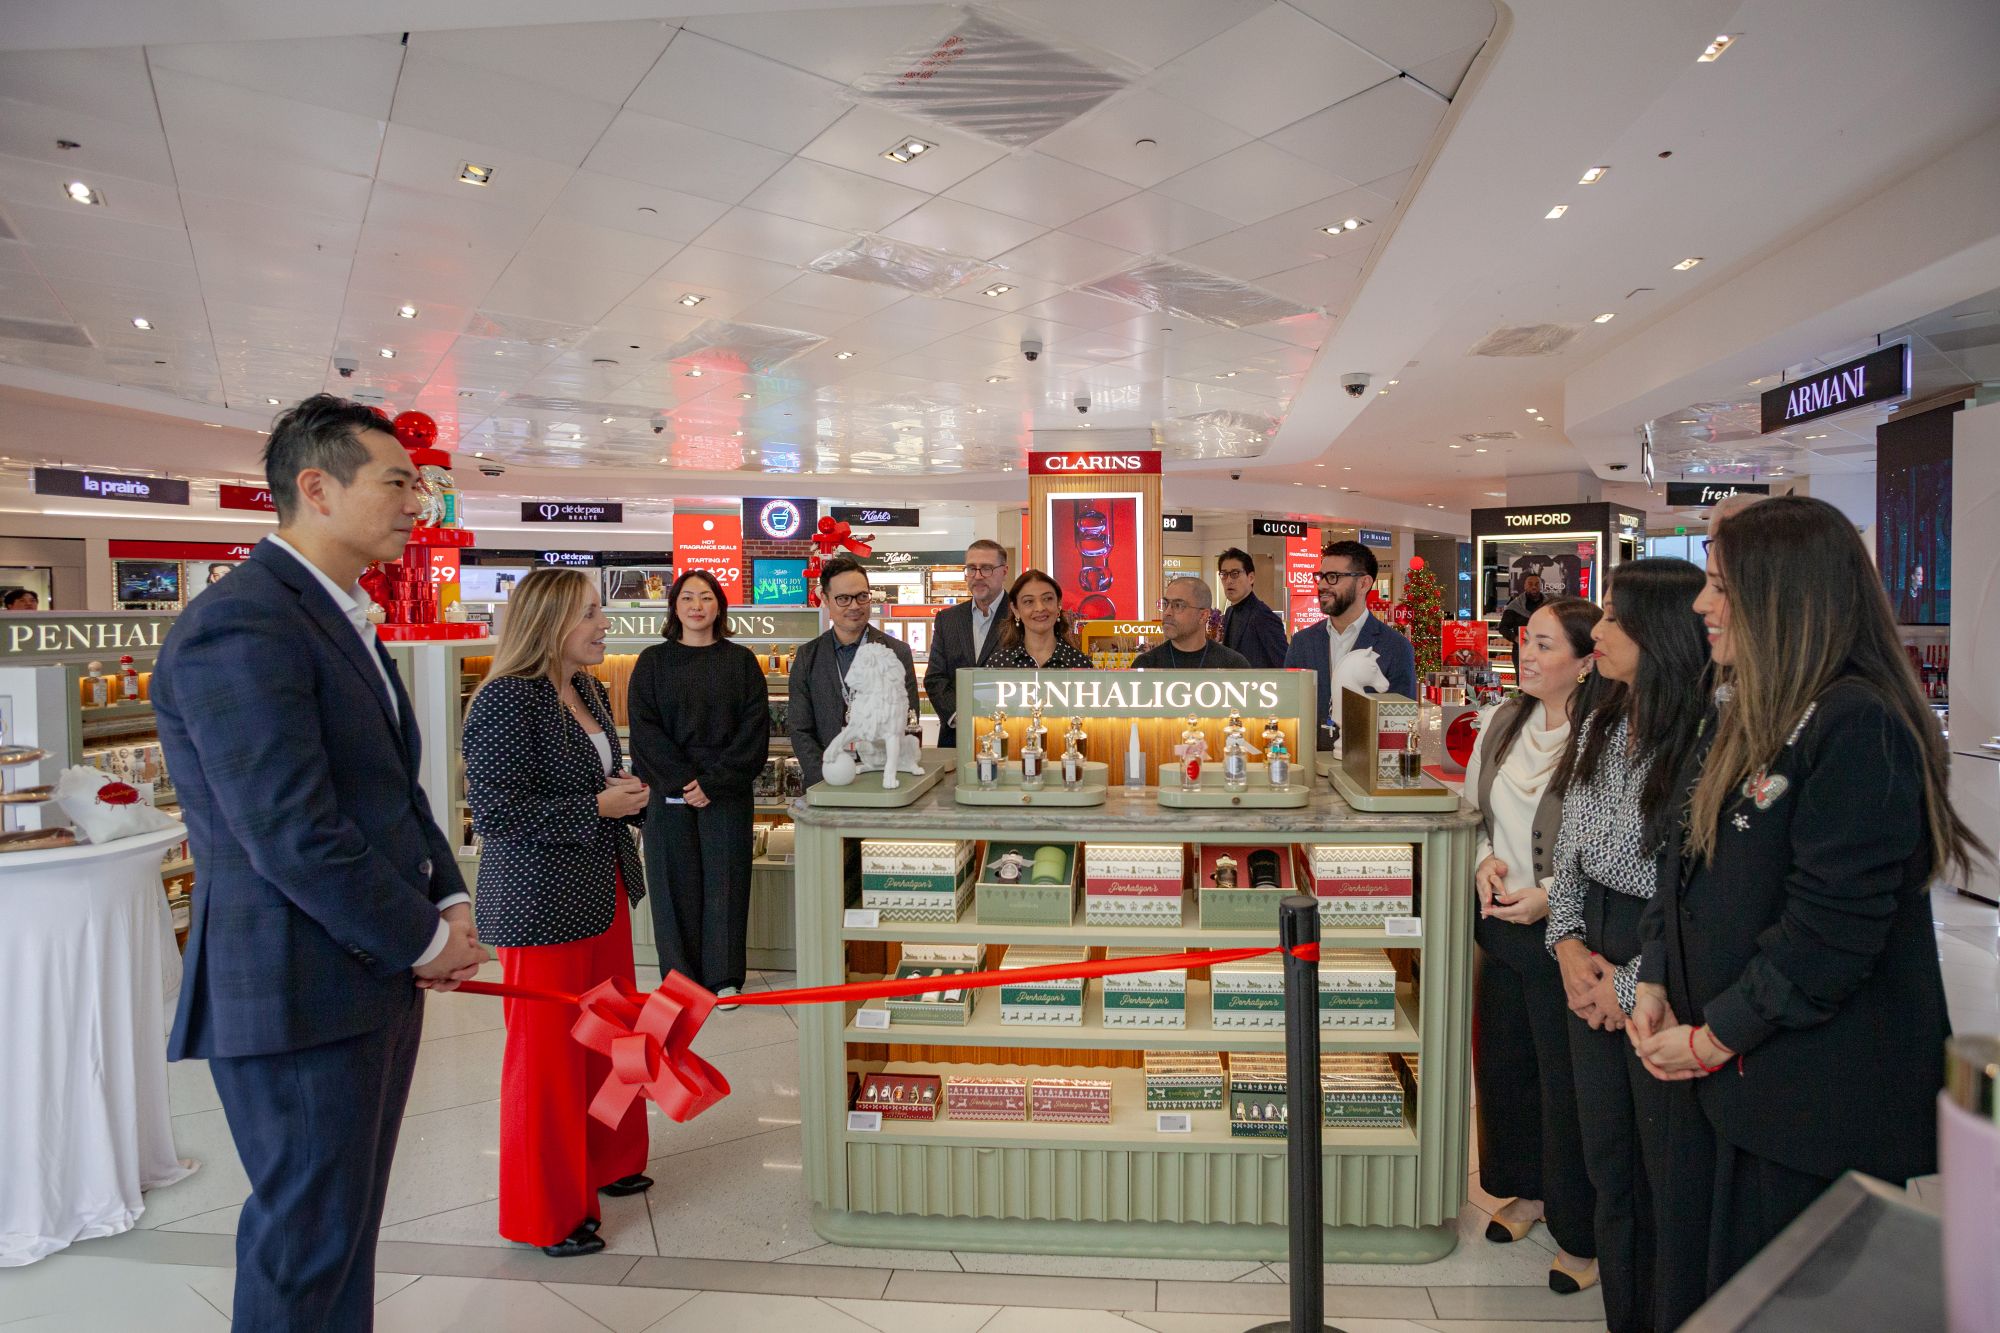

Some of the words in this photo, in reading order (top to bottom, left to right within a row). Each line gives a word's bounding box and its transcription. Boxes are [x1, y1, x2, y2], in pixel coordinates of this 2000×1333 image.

[1785, 365, 1865, 419] ARMANI
[1045, 456, 1142, 470] CLARINS
[84, 475, 99, 491] la
[101, 480, 150, 496] prairie
[860, 510, 891, 523] Kiehl's
[1163, 518, 1177, 528] BO
[1505, 514, 1533, 526] TOM
[1534, 513, 1571, 525] FORD
[1263, 523, 1300, 535] GUCCI
[431, 566, 456, 582] 29
[1288, 571, 1314, 584] US$2
[1395, 610, 1413, 619] DFS
[1114, 624, 1163, 634] L'OCCITA
[9, 623, 174, 651] PENHAL
[996, 681, 1279, 708] PENHALIGON'S
[884, 877, 933, 890] Penhaligon's
[1108, 882, 1159, 895] Penhaligon's
[1016, 991, 1066, 1003] Penhaligon's
[1120, 995, 1170, 1008] Penhaligon's
[1229, 996, 1279, 1009] Penhaligon's
